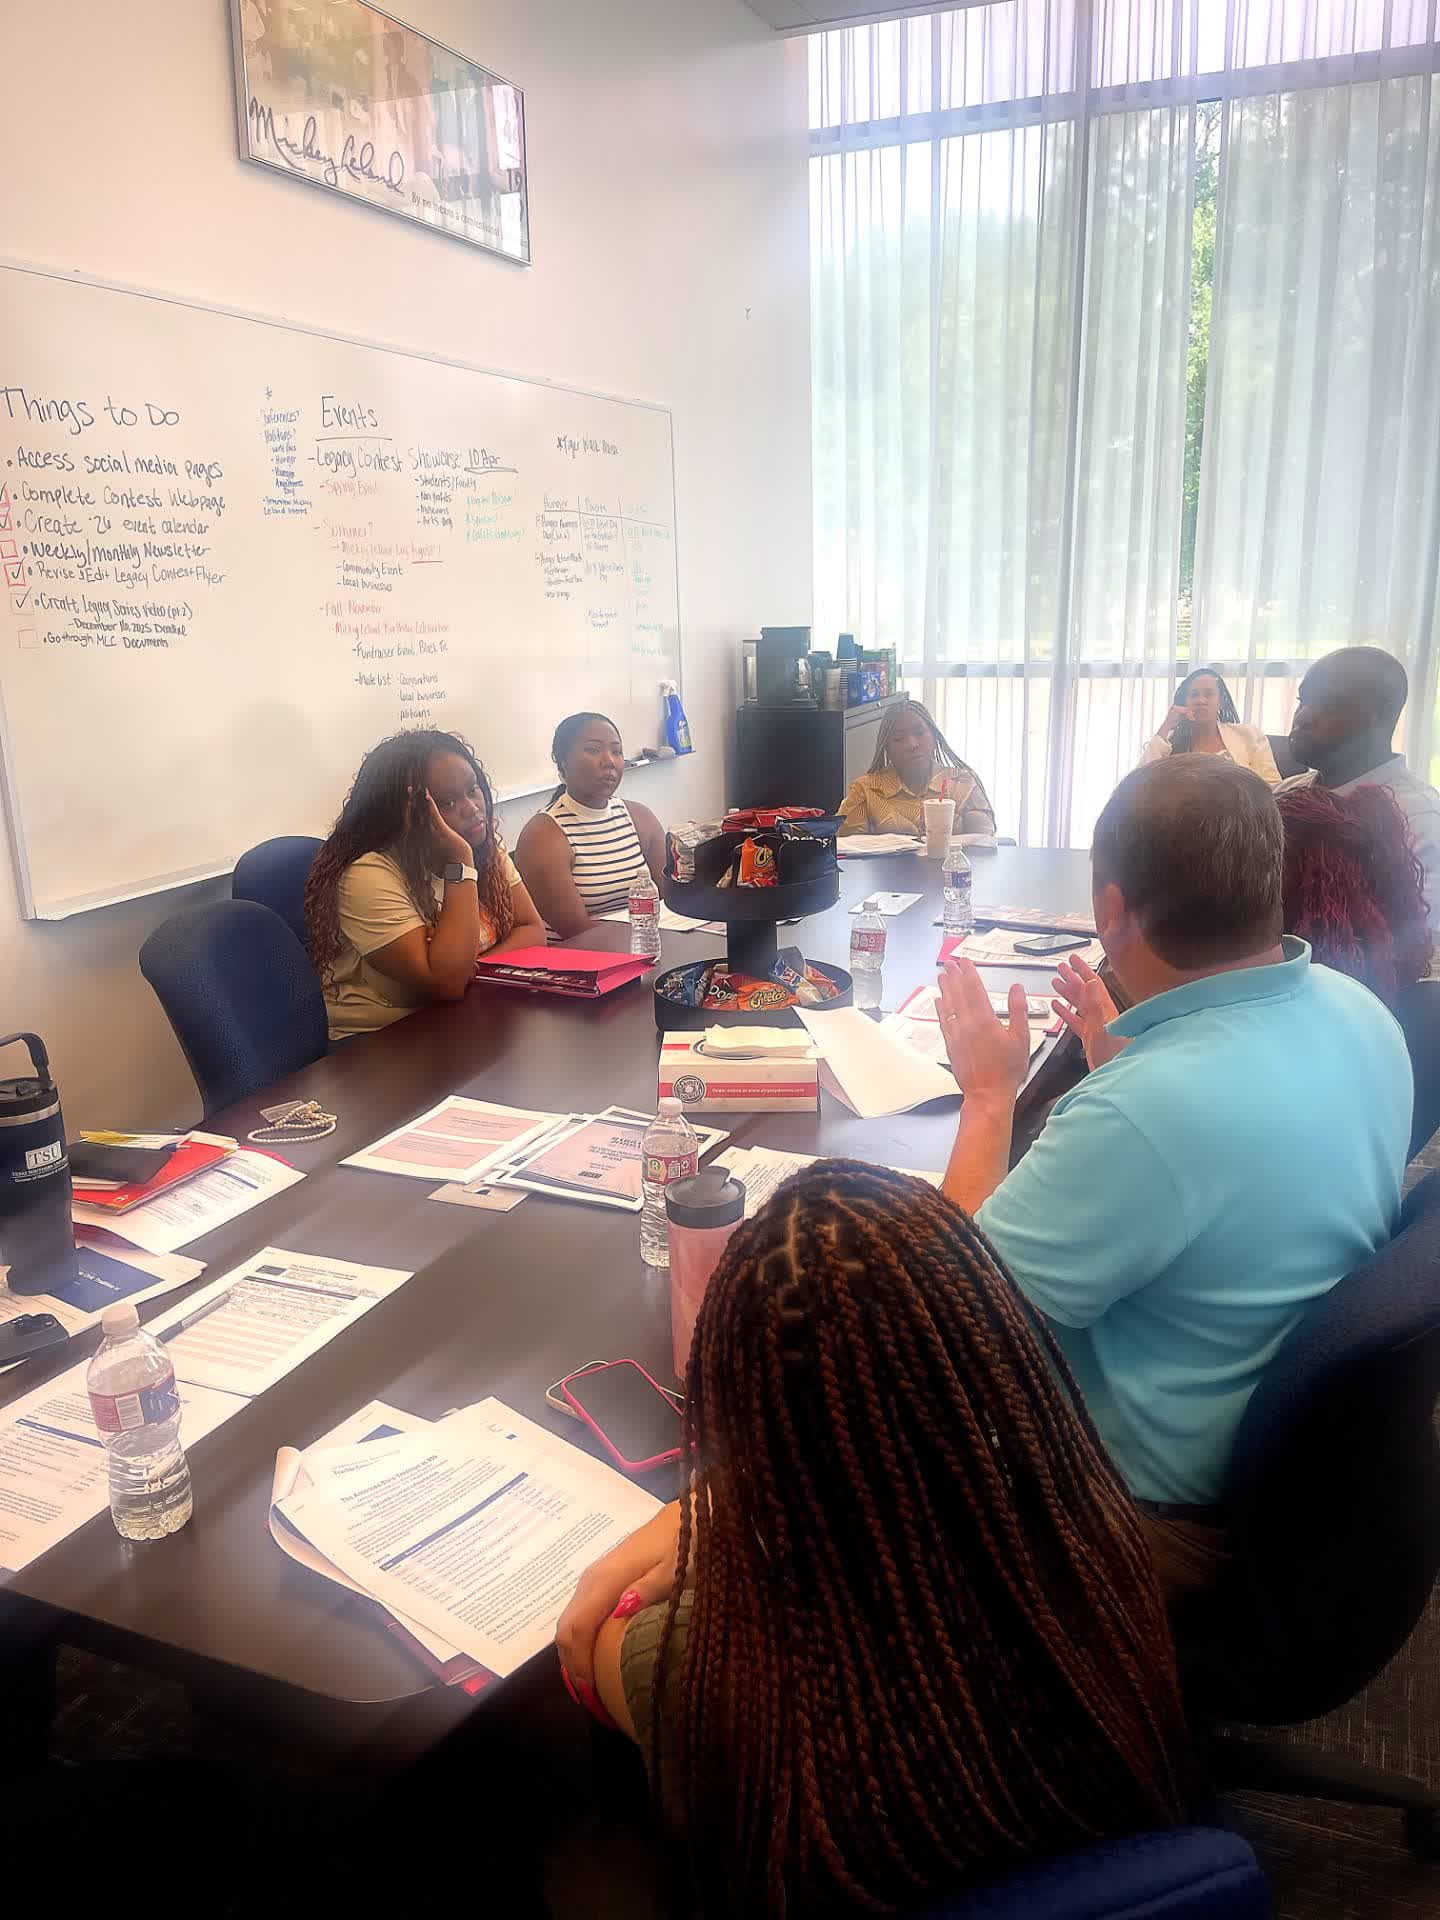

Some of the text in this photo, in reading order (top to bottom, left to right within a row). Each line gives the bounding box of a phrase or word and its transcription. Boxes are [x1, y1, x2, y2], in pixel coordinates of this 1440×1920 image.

[0, 387, 180, 435] Things to Do
[321, 395, 379, 430] Events
[18, 446, 223, 487] Access social media pages
[317, 445, 358, 479] Legacy
[358, 446, 404, 473] Contest
[22, 480, 226, 516] Complete Contest Webpage
[24, 508, 82, 536] Create
[123, 520, 156, 535] event
[161, 519, 209, 535] calendar
[143, 542, 211, 558] Newsletter
[37, 561, 75, 580] Revise
[115, 572, 149, 589] Legacy
[152, 564, 195, 587] Contest
[196, 566, 226, 584] Flyer
[342, 561, 403, 580] Community Event
[342, 577, 393, 592] Local businesses
[40, 592, 79, 614] Create
[73, 617, 116, 632] December
[132, 622, 151, 633] 2025
[47, 631, 61, 644] Go
[97, 634, 117, 647] MLC
[123, 637, 169, 649] Documents
[356, 642, 394, 659] Fundraiser
[749, 989, 787, 1009] Cheetos
[28, 1146, 60, 1165] TSU
